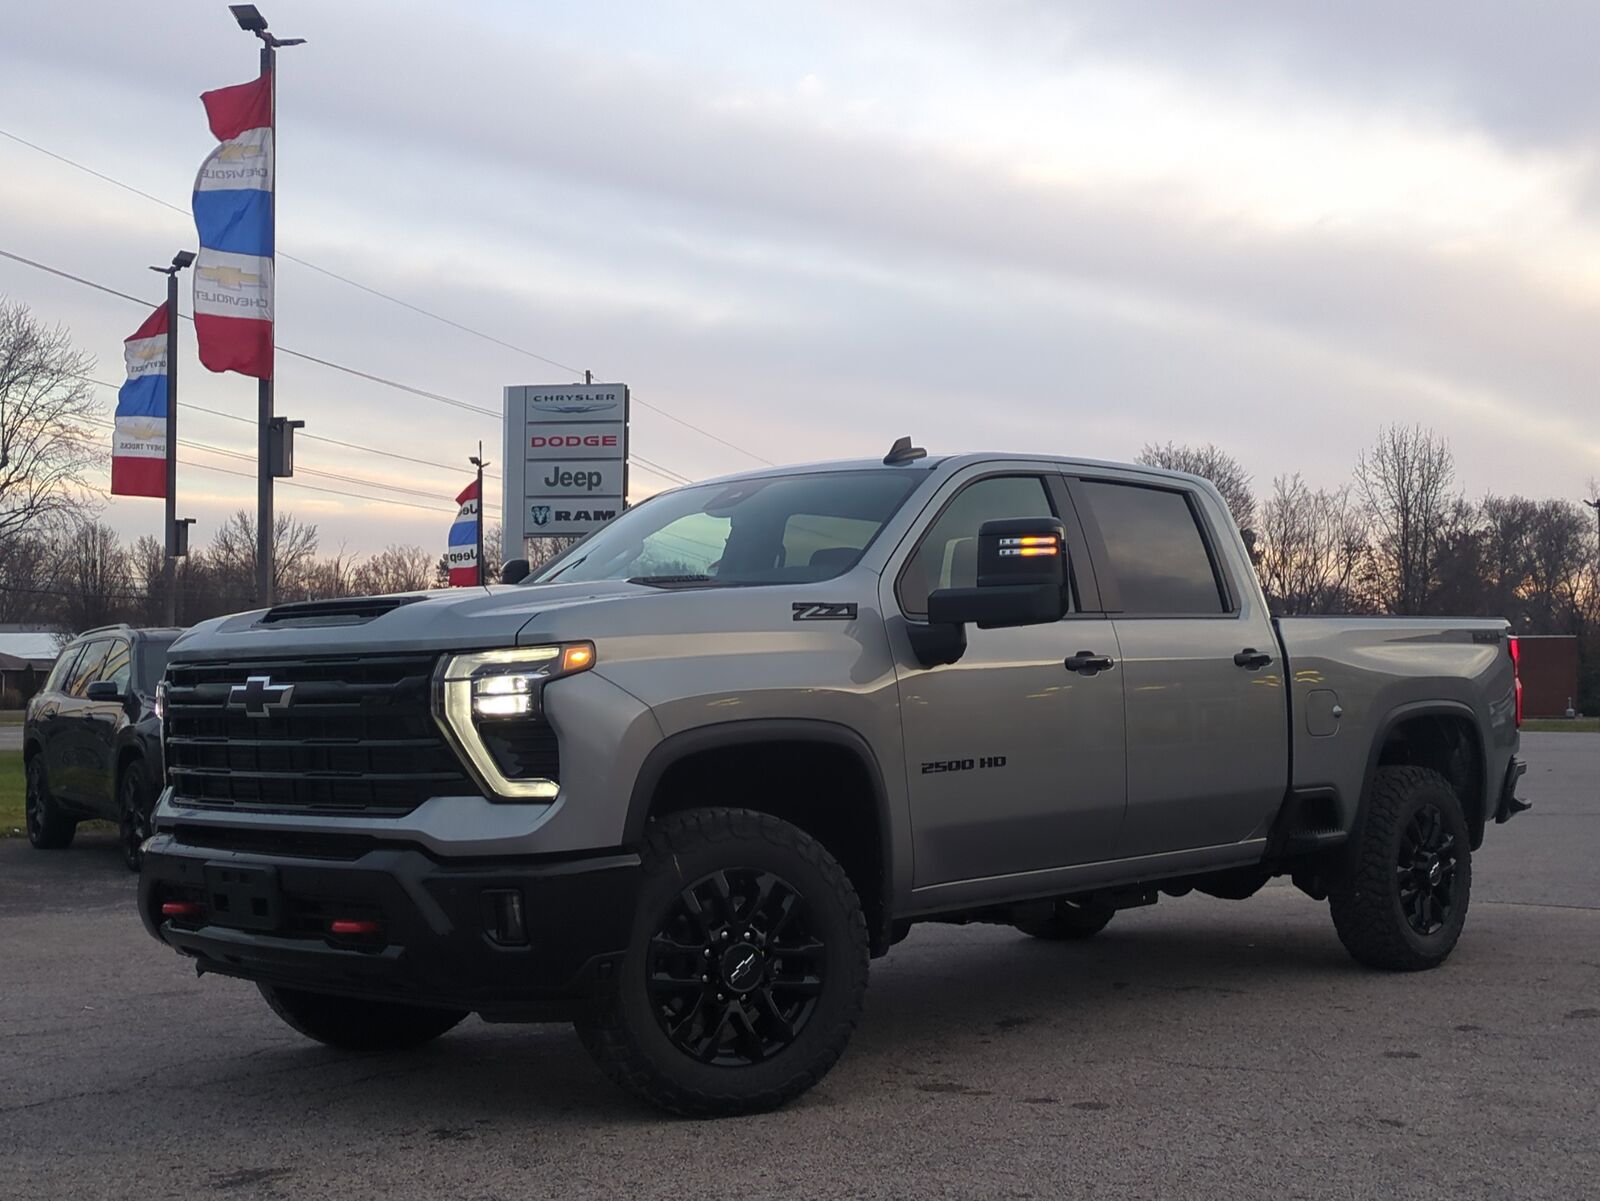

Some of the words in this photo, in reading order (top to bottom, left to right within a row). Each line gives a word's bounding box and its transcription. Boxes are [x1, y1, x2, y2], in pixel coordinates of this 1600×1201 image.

[533, 393, 616, 402] CHRYSLER
[531, 435, 617, 448] DODGE
[544, 466, 602, 491] Jeep
[554, 510, 616, 522] RAM
[921, 759, 974, 774] 2500
[979, 756, 1006, 768] HD
